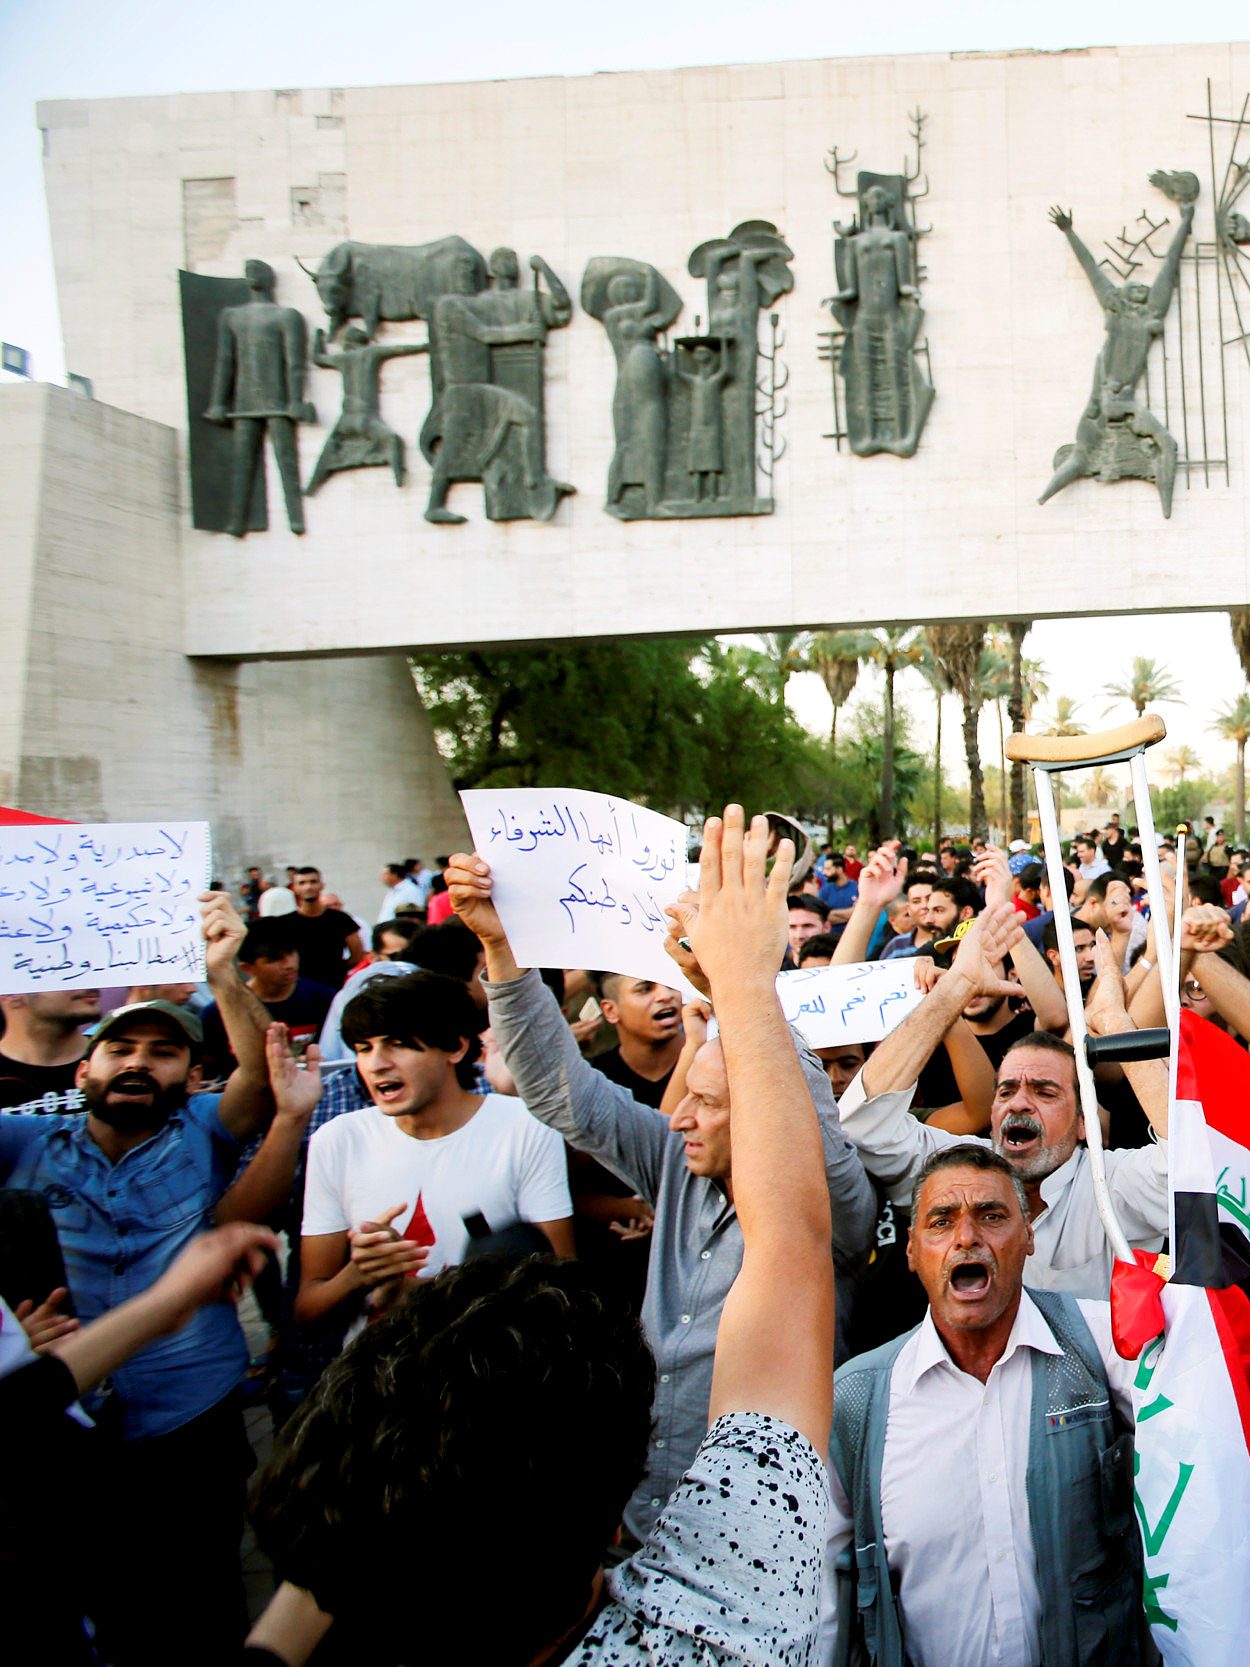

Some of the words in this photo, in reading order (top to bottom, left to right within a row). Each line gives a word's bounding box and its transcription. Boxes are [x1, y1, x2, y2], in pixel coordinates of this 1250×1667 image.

[489, 803, 580, 852] الشرفاء
[840, 986, 867, 1027] نعم
[879, 983, 908, 1028] نعم
